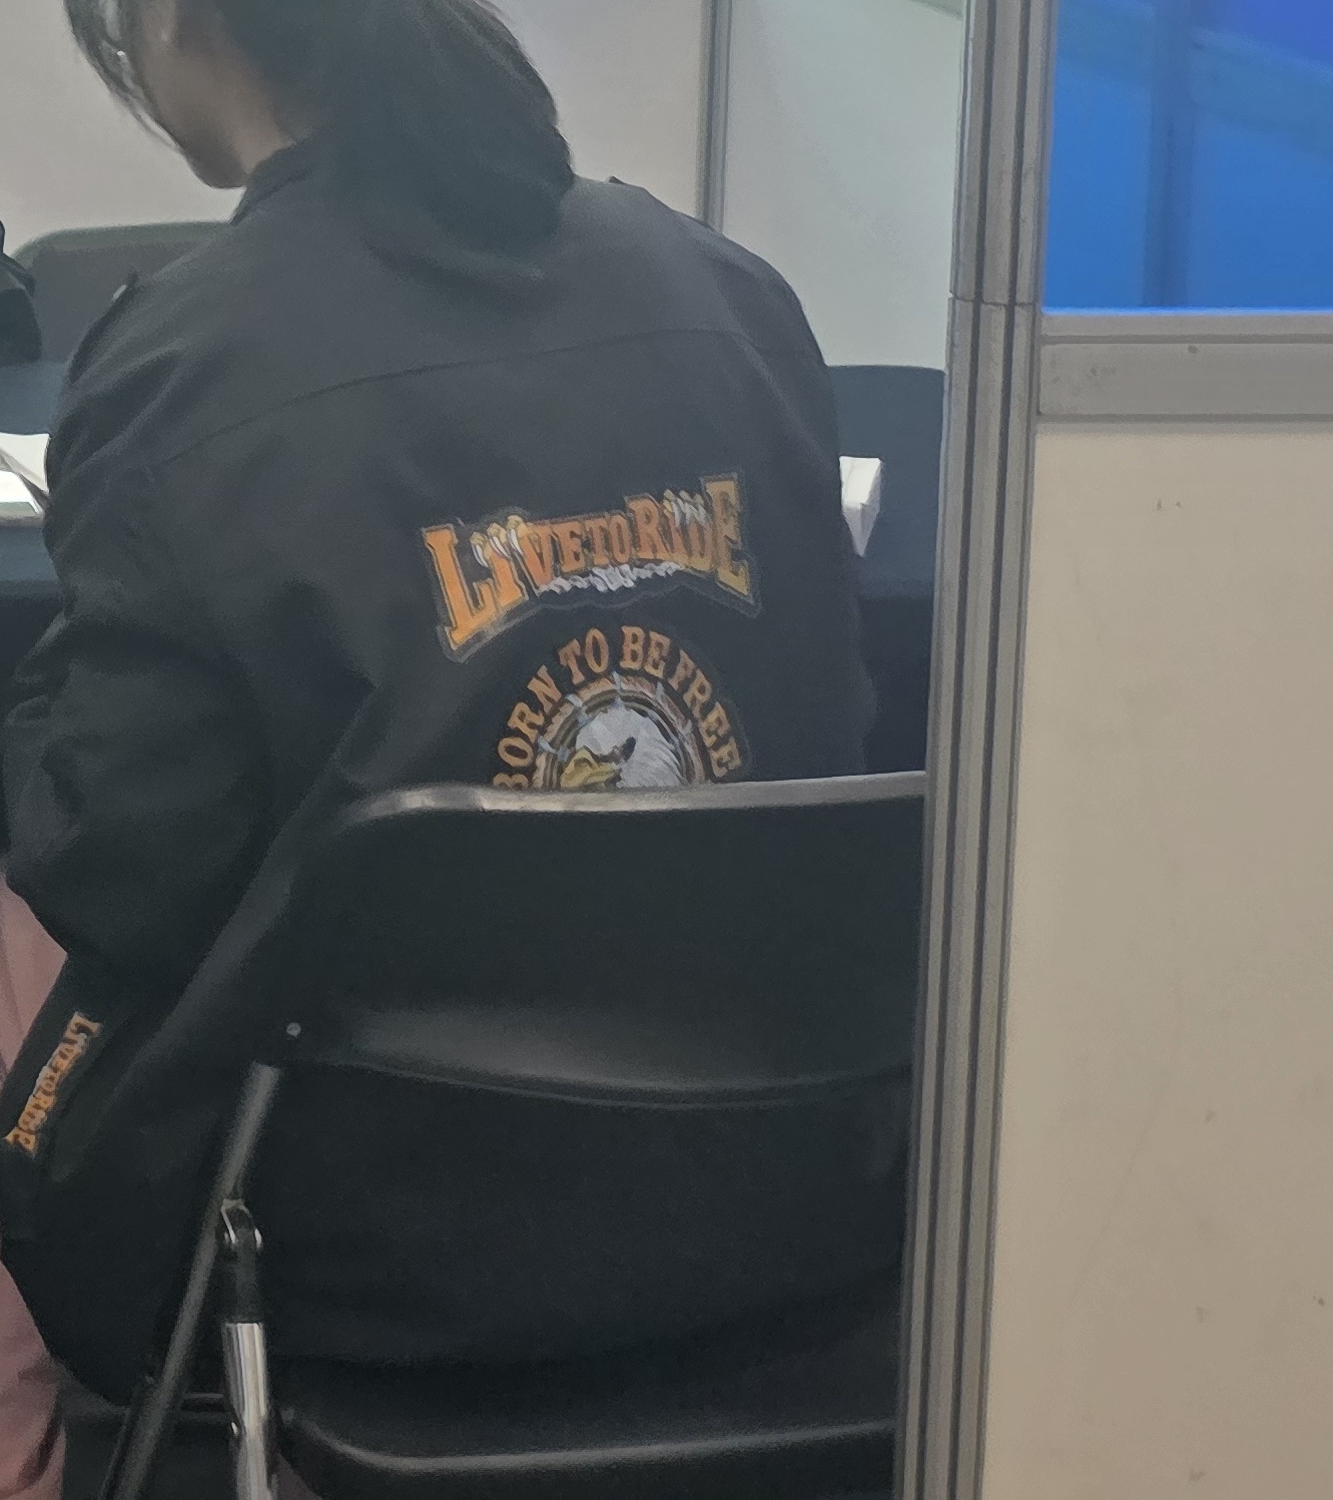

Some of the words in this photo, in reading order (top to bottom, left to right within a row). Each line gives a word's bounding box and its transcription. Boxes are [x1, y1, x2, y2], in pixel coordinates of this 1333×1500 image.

[557, 627, 610, 685] TO
[619, 625, 672, 678] BE
[667, 649, 741, 779] FREE
